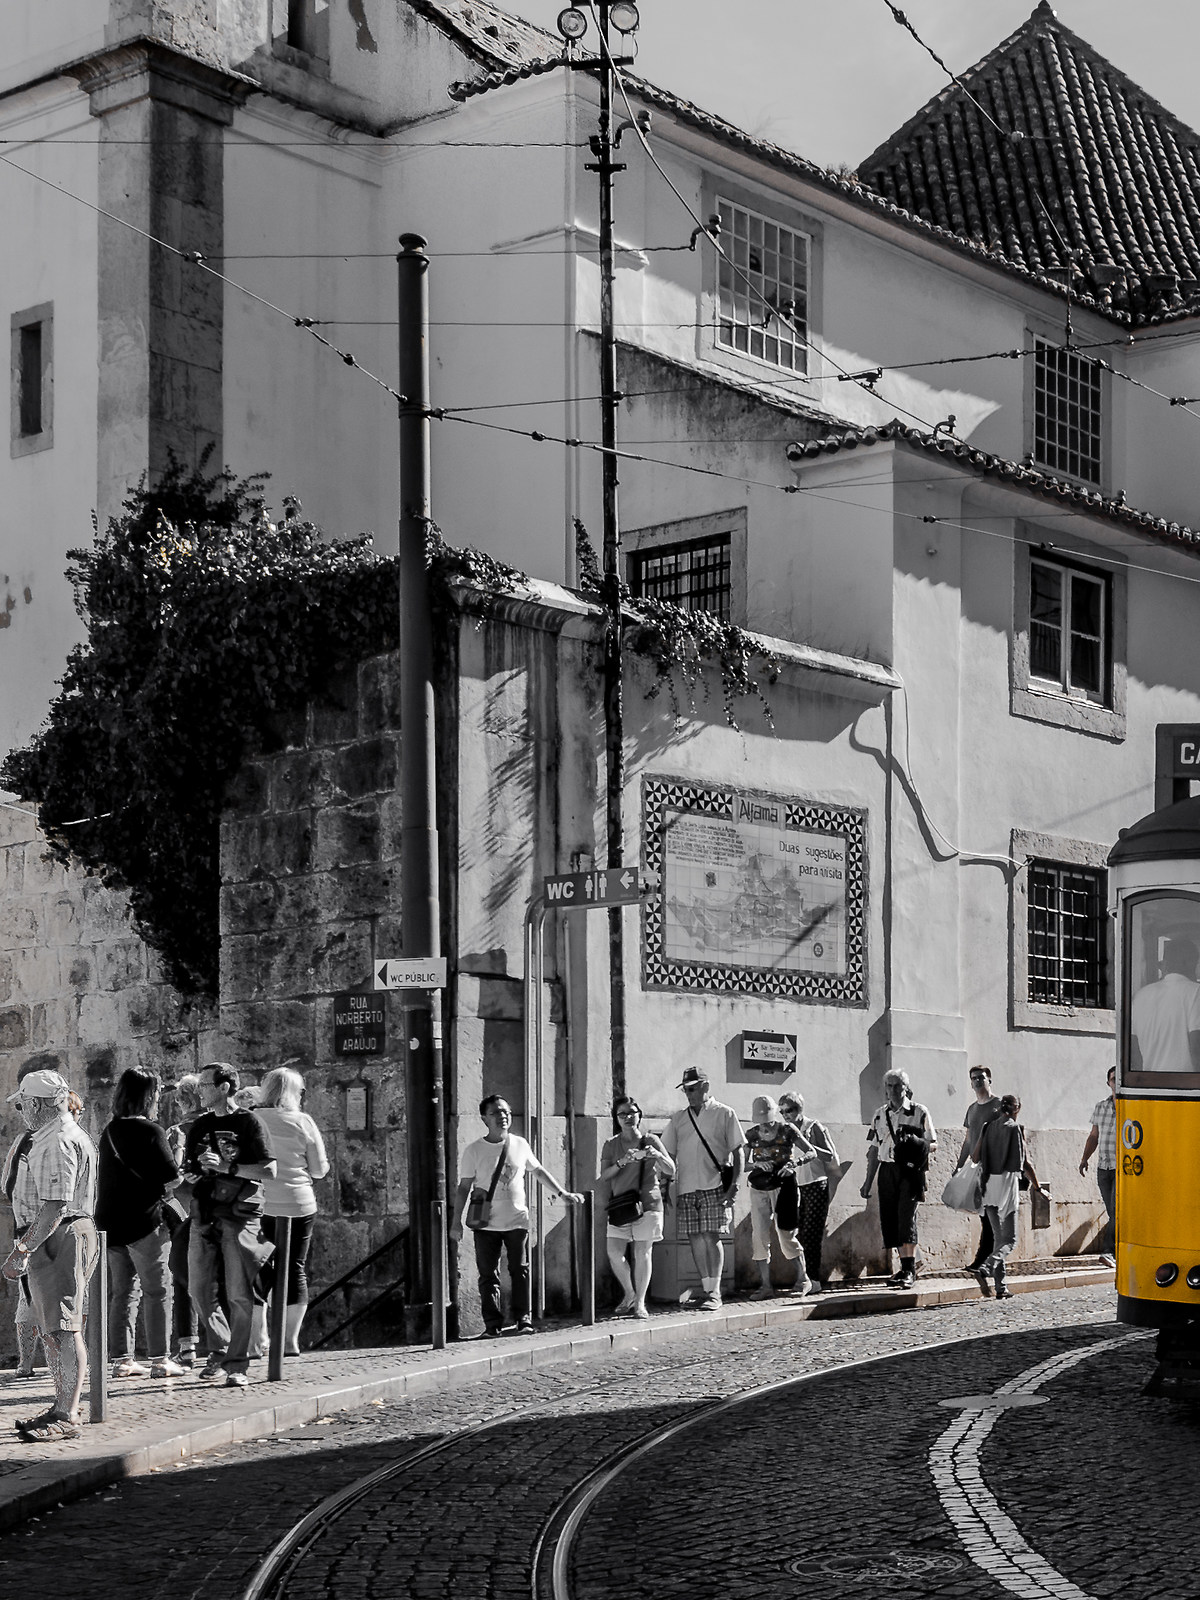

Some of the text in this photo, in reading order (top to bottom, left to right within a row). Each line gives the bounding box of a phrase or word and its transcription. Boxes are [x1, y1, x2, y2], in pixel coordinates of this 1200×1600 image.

[739, 798, 778, 823] Alfama
[779, 840, 800, 855] Duas
[799, 864, 843, 880] para visita
[547, 881, 575, 900] WC
[390, 971, 440, 984] WC PÚBLIC
[350, 996, 368, 1010] RUA
[336, 1010, 383, 1026] NORBERTO
